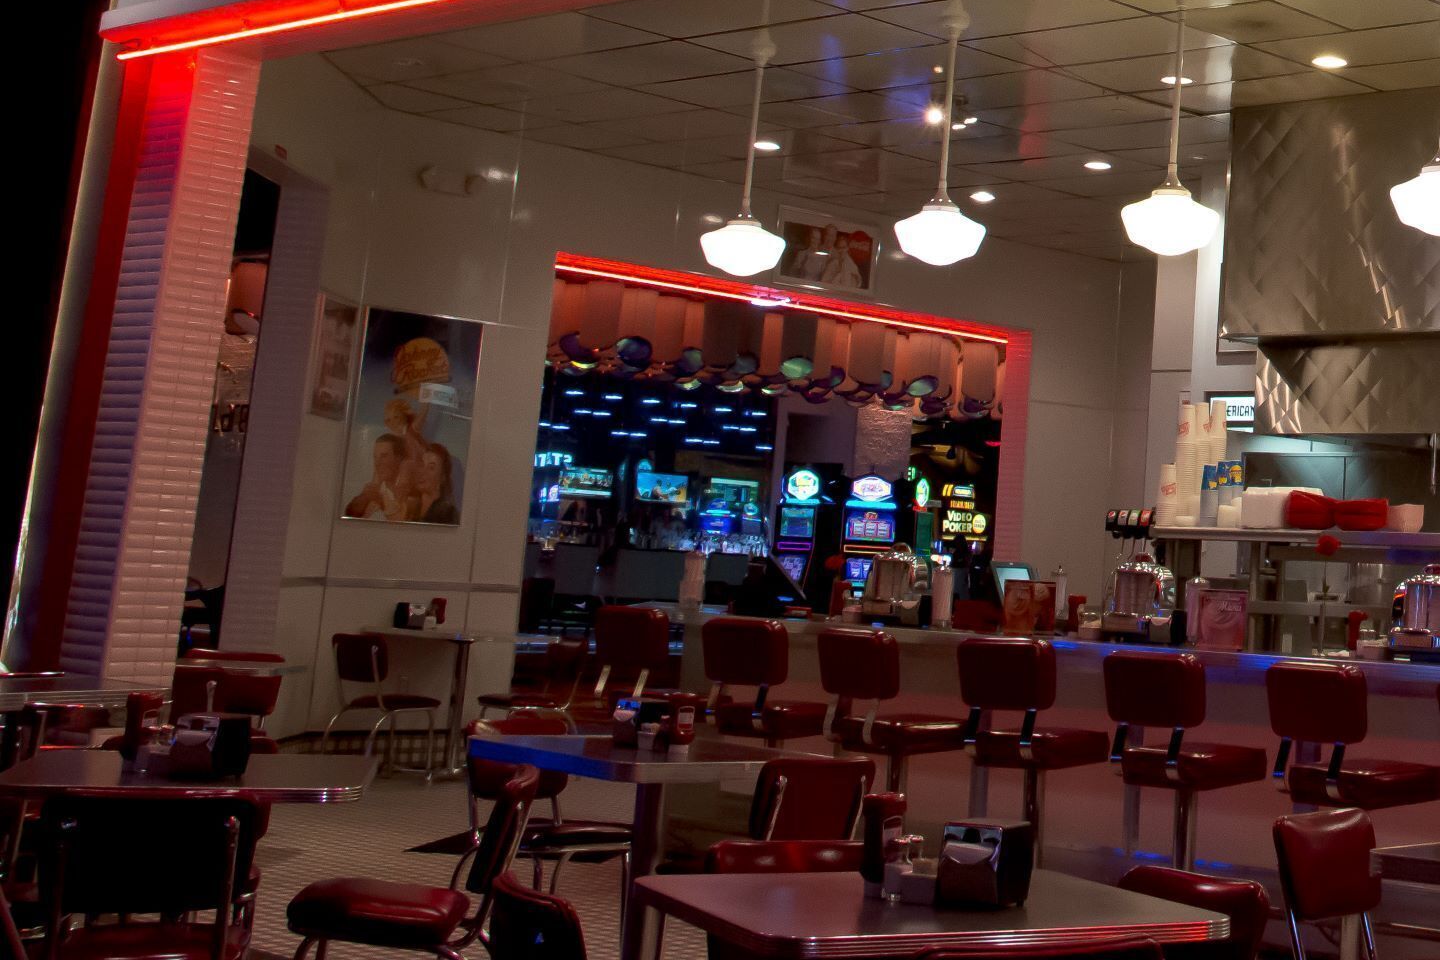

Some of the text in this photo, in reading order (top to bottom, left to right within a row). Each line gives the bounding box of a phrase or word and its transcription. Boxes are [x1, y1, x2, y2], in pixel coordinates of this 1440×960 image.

[1226, 405, 1255, 417] ERICAN
[946, 510, 972, 522] VIDEO
[942, 519, 972, 533] POKER
